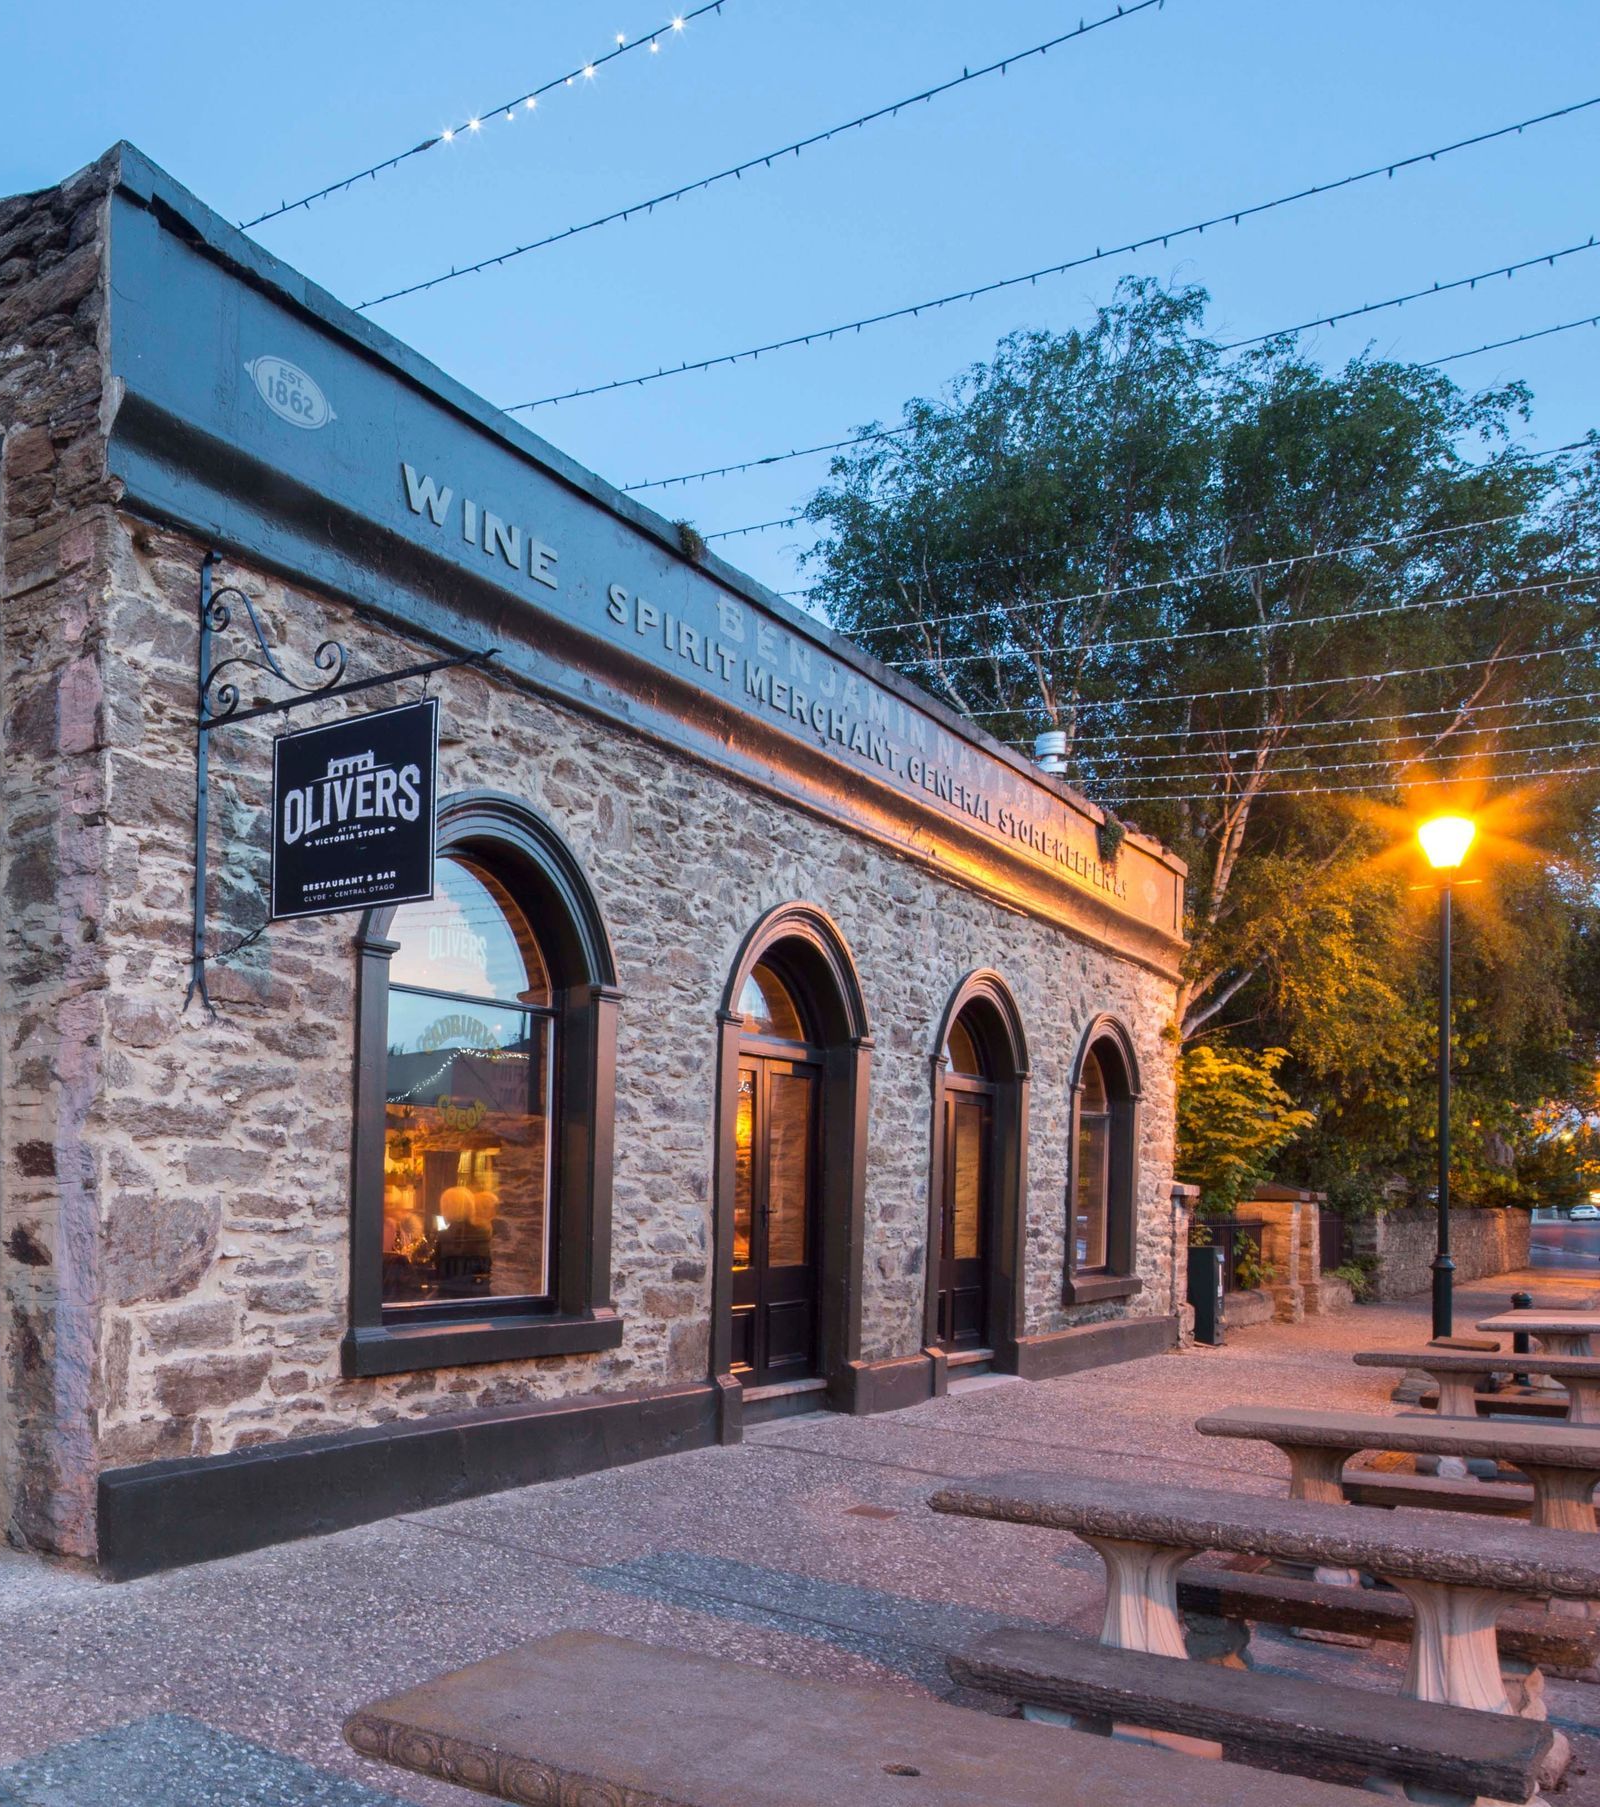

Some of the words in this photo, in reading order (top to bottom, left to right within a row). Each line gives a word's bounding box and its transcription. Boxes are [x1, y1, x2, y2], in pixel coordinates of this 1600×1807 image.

[268, 376, 314, 420] 1862
[403, 462, 560, 590] WINE
[607, 583, 736, 682] SPIRIT
[908, 756, 997, 828] GENERAL
[719, 593, 927, 752] BENJAMIN
[283, 763, 421, 845] OLIVERS
[314, 833, 355, 846] VICTORIA
[357, 827, 385, 838] STORE
[302, 875, 364, 892] RESTAURANT
[376, 871, 396, 880] BAR
[303, 893, 326, 903] CLYDE
[334, 888, 366, 898] CENTRAL
[369, 883, 395, 893] OTAGO
[428, 926, 488, 971] OLIVERS
